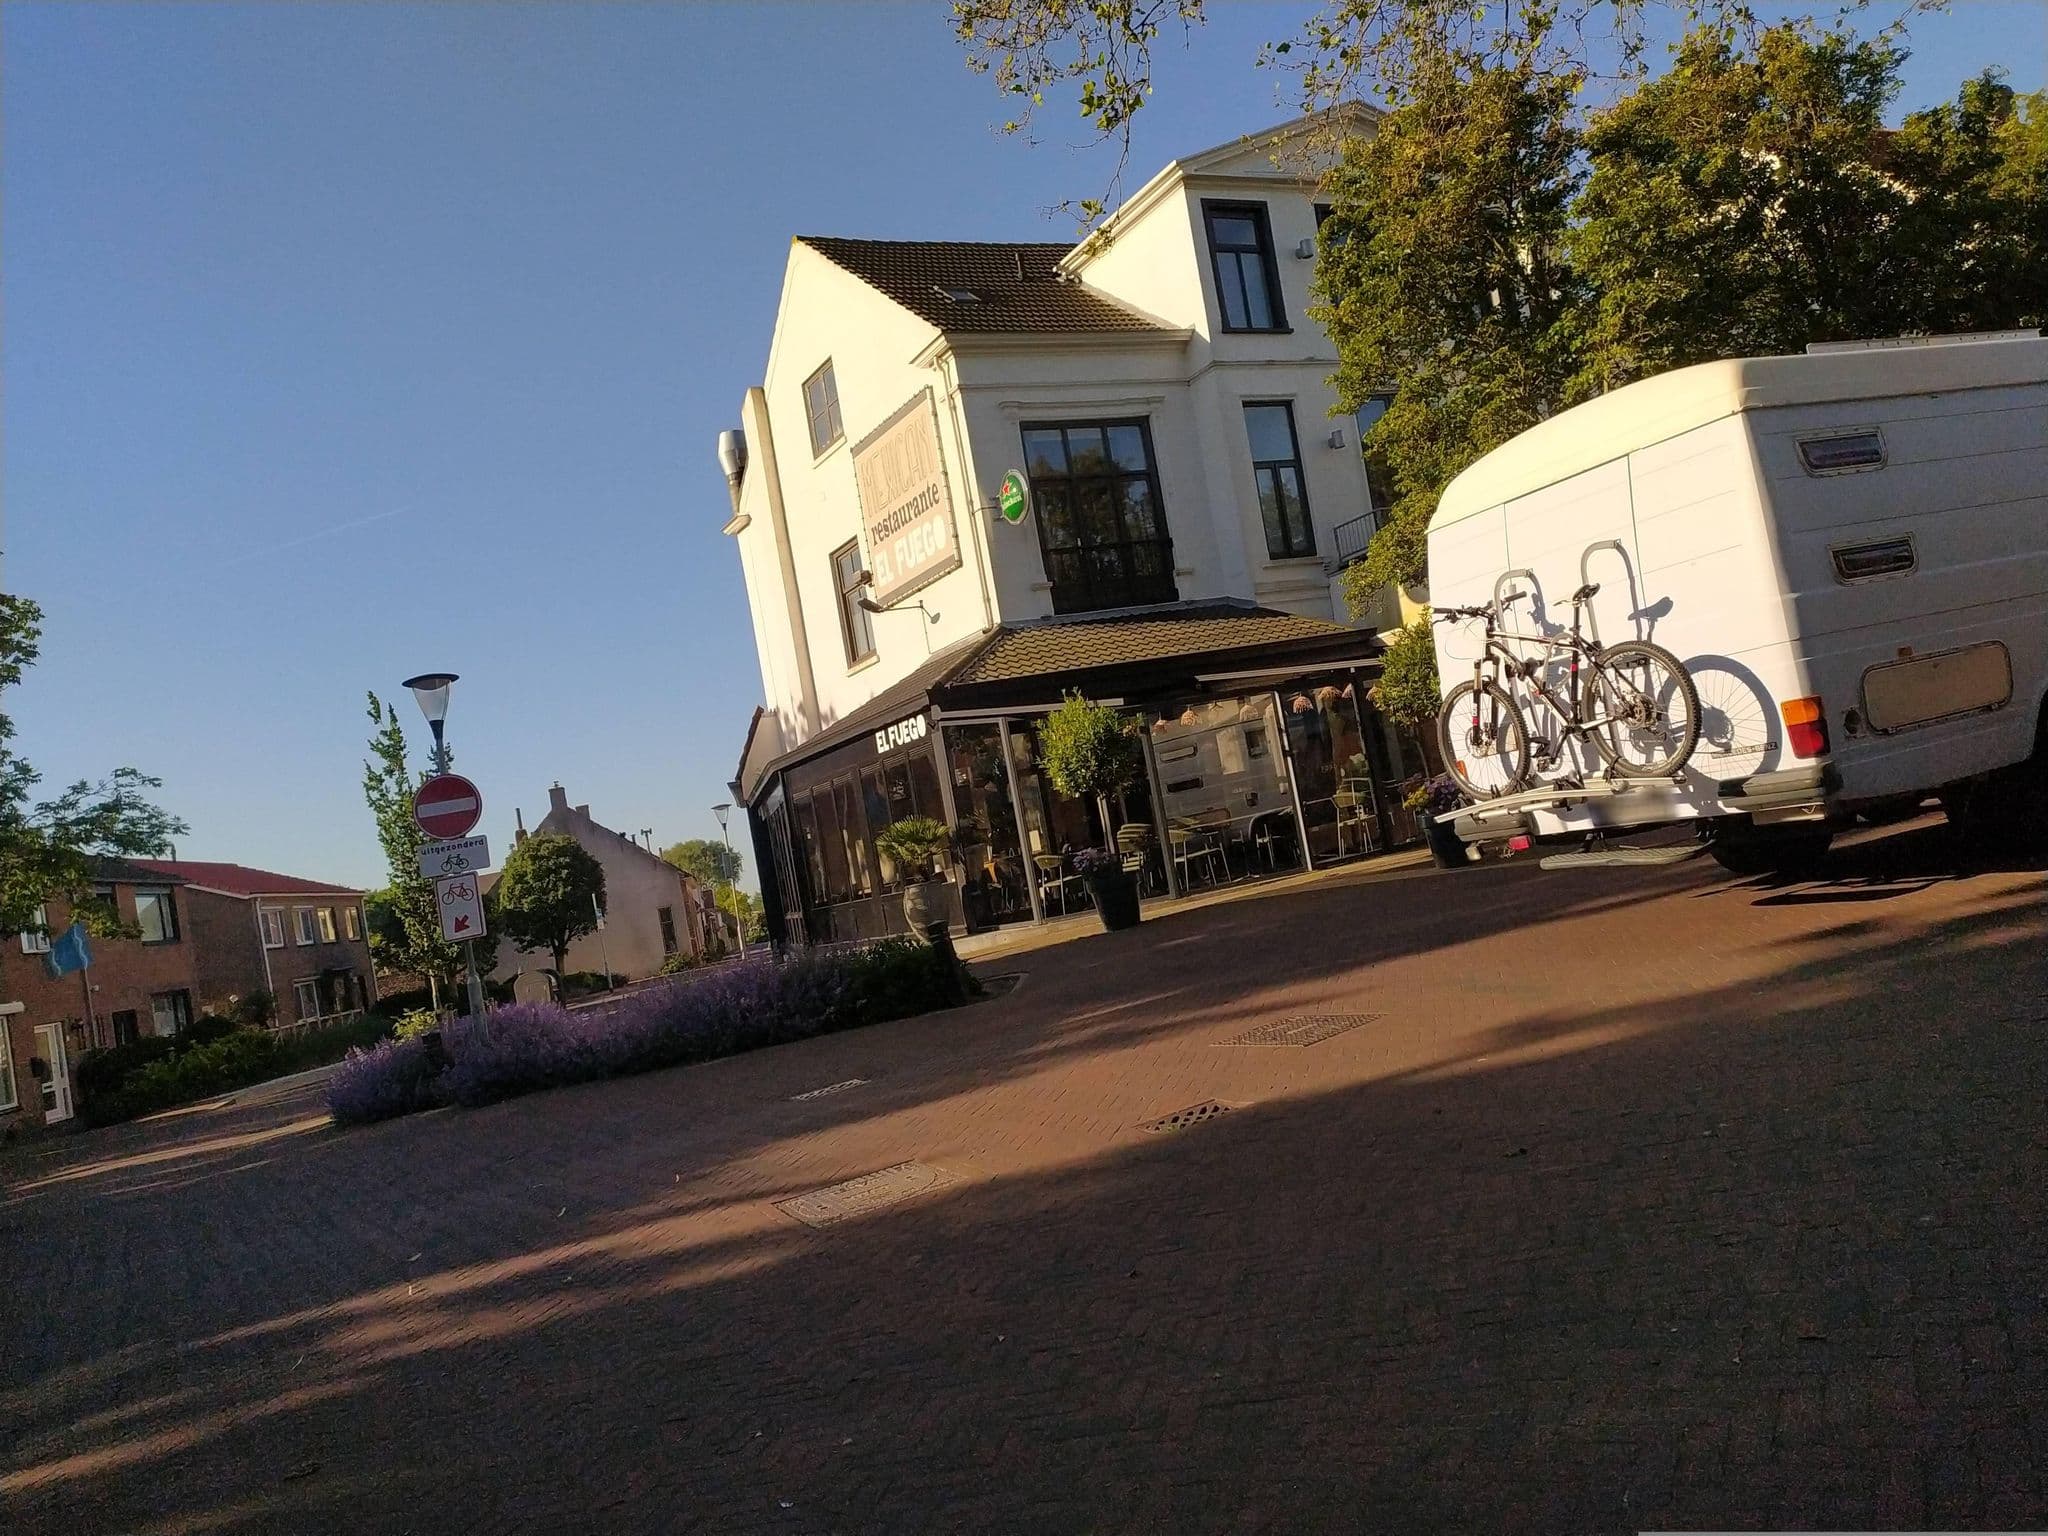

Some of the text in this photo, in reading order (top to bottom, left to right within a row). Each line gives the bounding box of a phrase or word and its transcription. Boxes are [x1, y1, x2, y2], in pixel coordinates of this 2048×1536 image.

[859, 416, 936, 517] MEXICAN
[871, 481, 940, 546] restaurante
[874, 515, 946, 587] EL FUEGO
[875, 714, 927, 754] EL FUEGO
[421, 839, 484, 856] uitgezonderd
